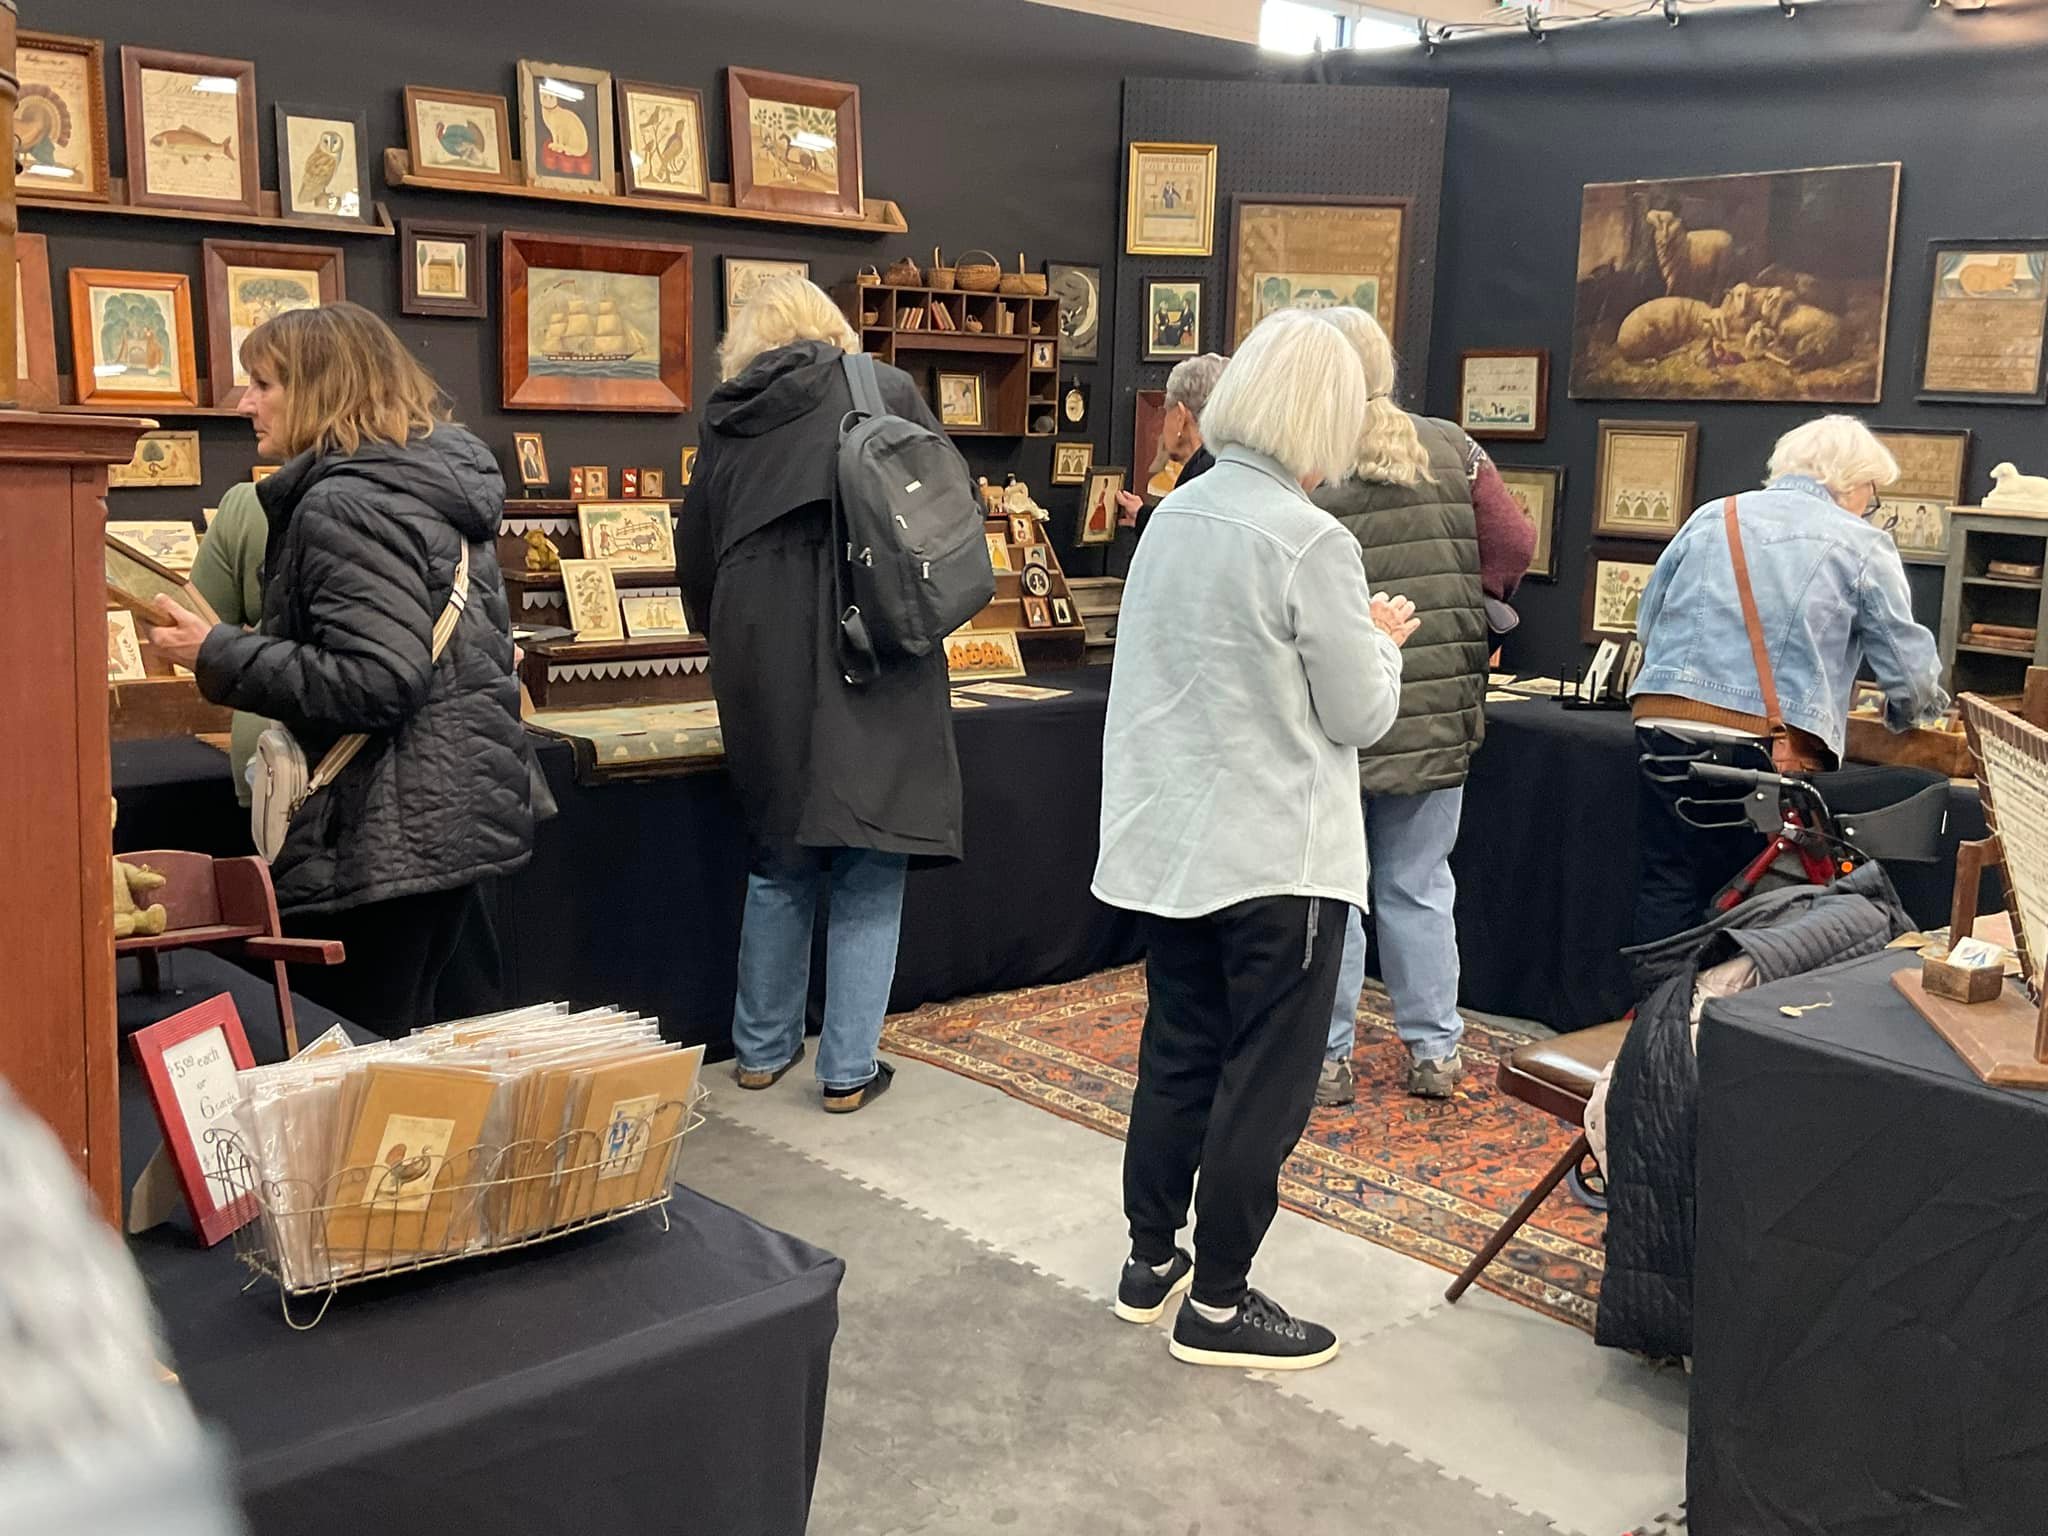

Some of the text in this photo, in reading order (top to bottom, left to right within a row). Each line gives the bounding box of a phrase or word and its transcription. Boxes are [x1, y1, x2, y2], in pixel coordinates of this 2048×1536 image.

[197, 1047, 220, 1067] each
[196, 1079, 207, 1090] or
[200, 1095, 215, 1119] 6
